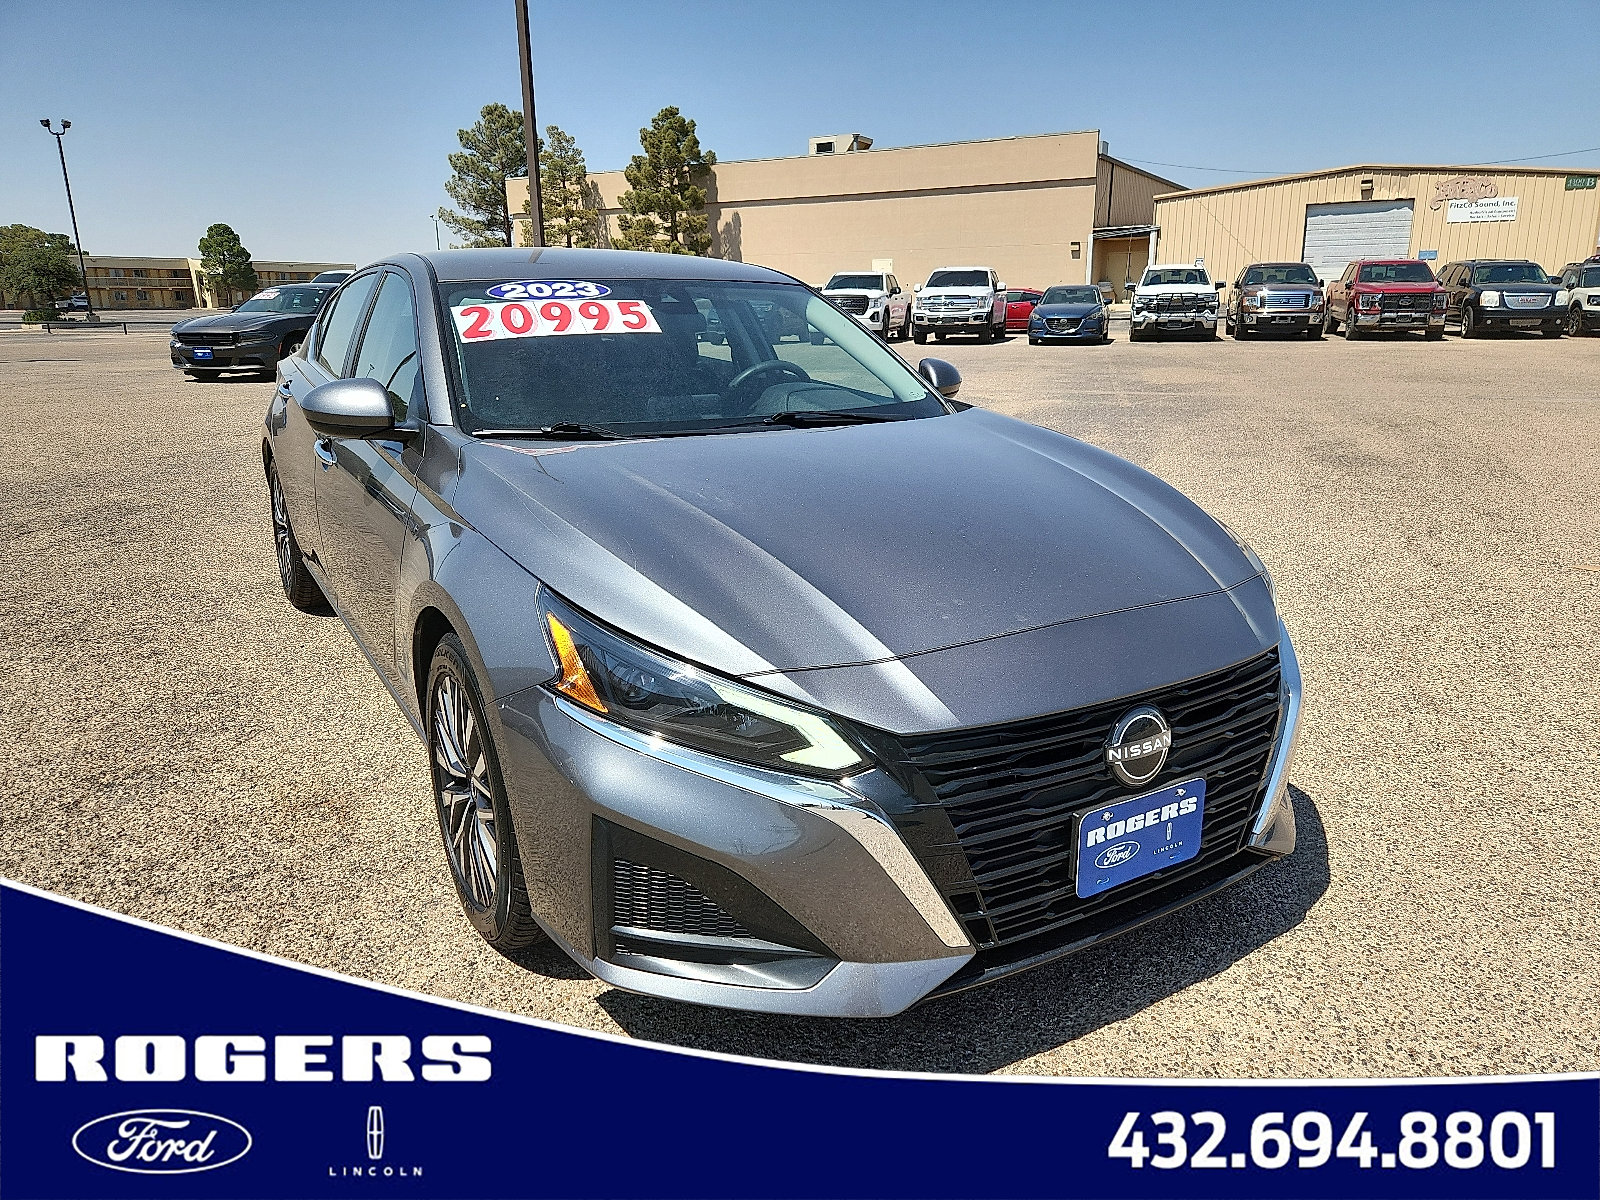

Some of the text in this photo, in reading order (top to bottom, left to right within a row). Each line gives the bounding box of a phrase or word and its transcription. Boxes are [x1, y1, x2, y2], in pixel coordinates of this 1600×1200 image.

[1474, 200, 1500, 208] Sound,
[500, 282, 601, 298] 2023
[460, 301, 649, 339] 20995
[1108, 729, 1171, 761] NISSAN
[1086, 796, 1198, 848] ROGERS
[1103, 844, 1132, 866] Ford
[1153, 840, 1183, 855] LINCOLN
